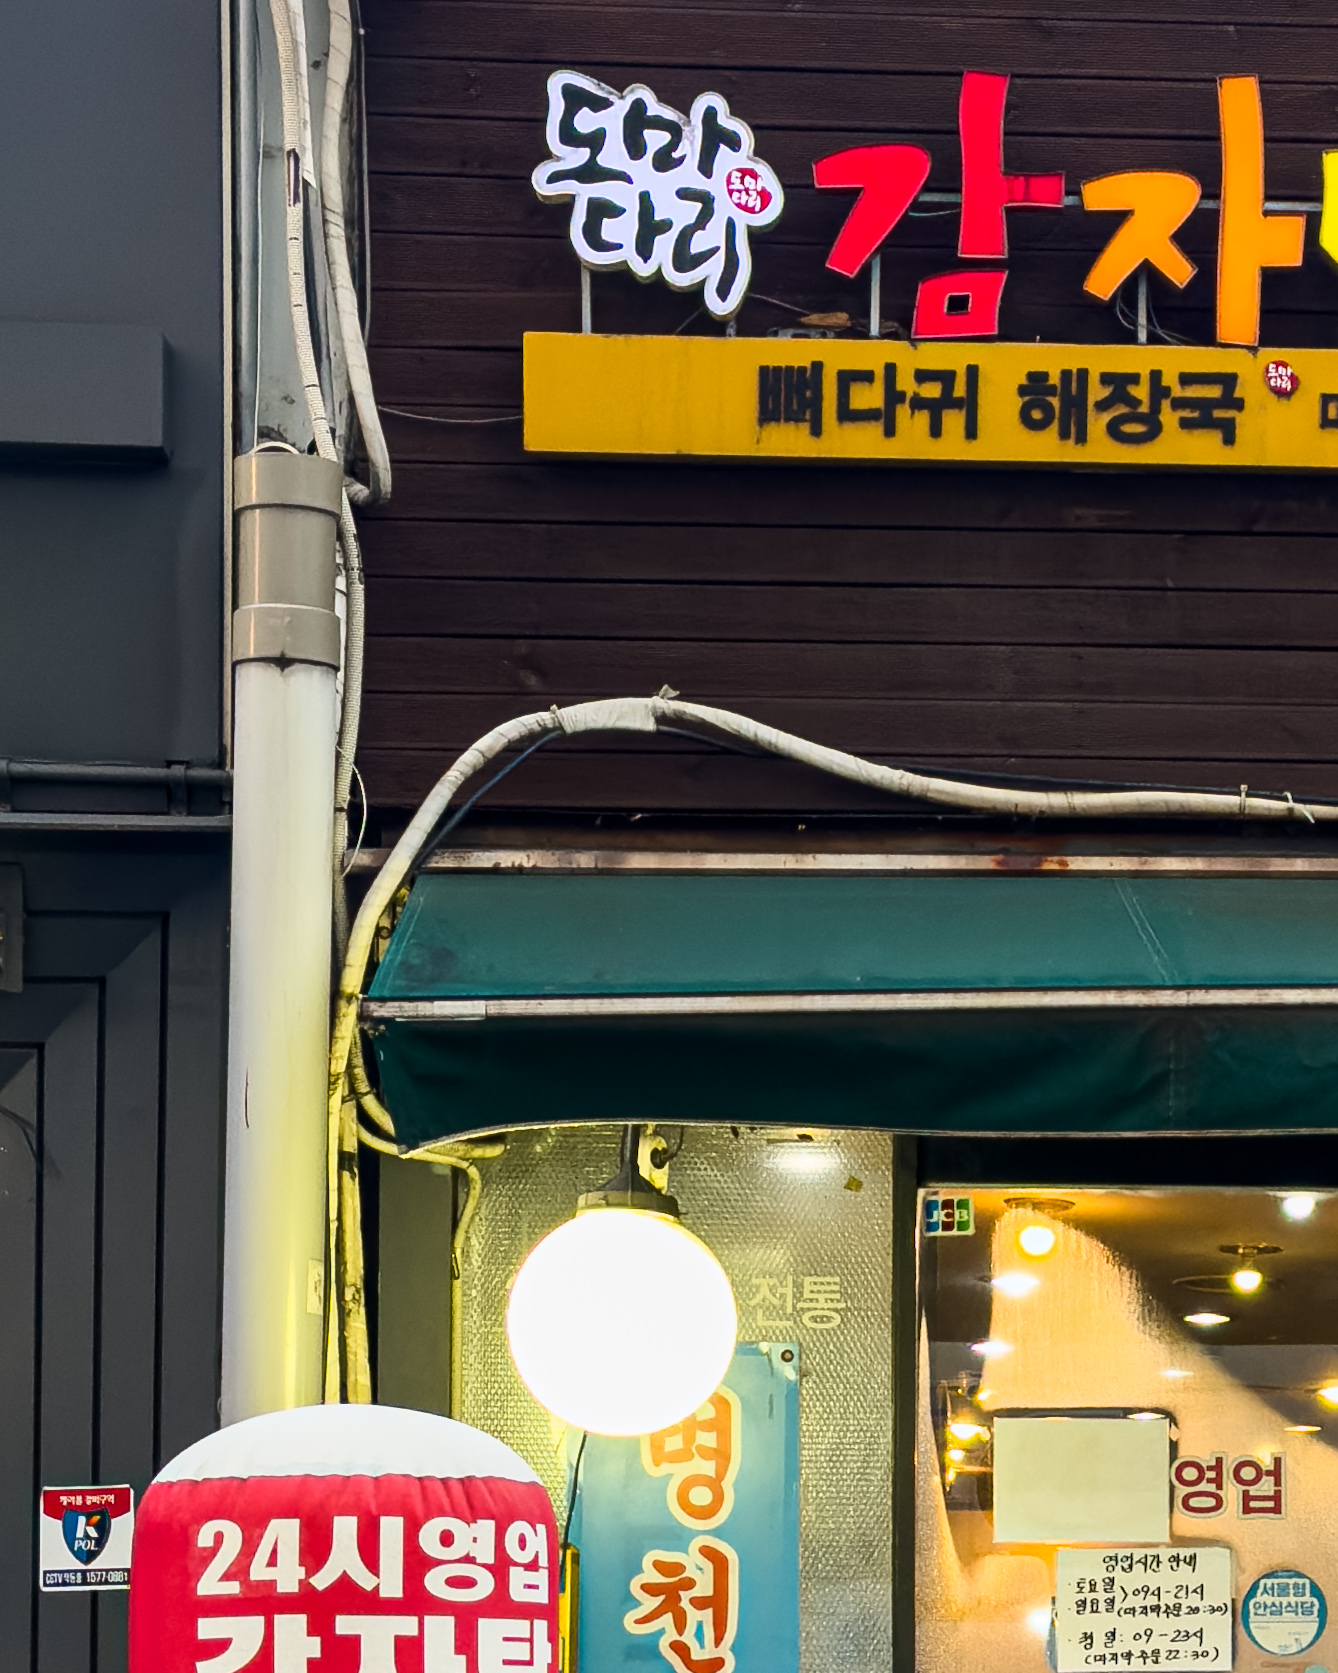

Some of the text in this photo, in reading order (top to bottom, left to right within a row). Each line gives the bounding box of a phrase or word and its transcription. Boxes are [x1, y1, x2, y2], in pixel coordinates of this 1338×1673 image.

[545, 80, 741, 186] 도마
[582, 185, 738, 303] 다리
[758, 361, 1246, 446] 뼈다귀 해장국
[749, 1275, 847, 1329] 전통
[1174, 1456, 1285, 1515] 영업
[74, 1539, 99, 1551] POL
[195, 1515, 549, 1604] 24시영업
[1102, 1552, 1198, 1574] 영업시간 안내
[1074, 1576, 1116, 1594] 토요일
[1074, 1596, 1116, 1616] 일요일
[1252, 1600, 1316, 1617] 안심식당
